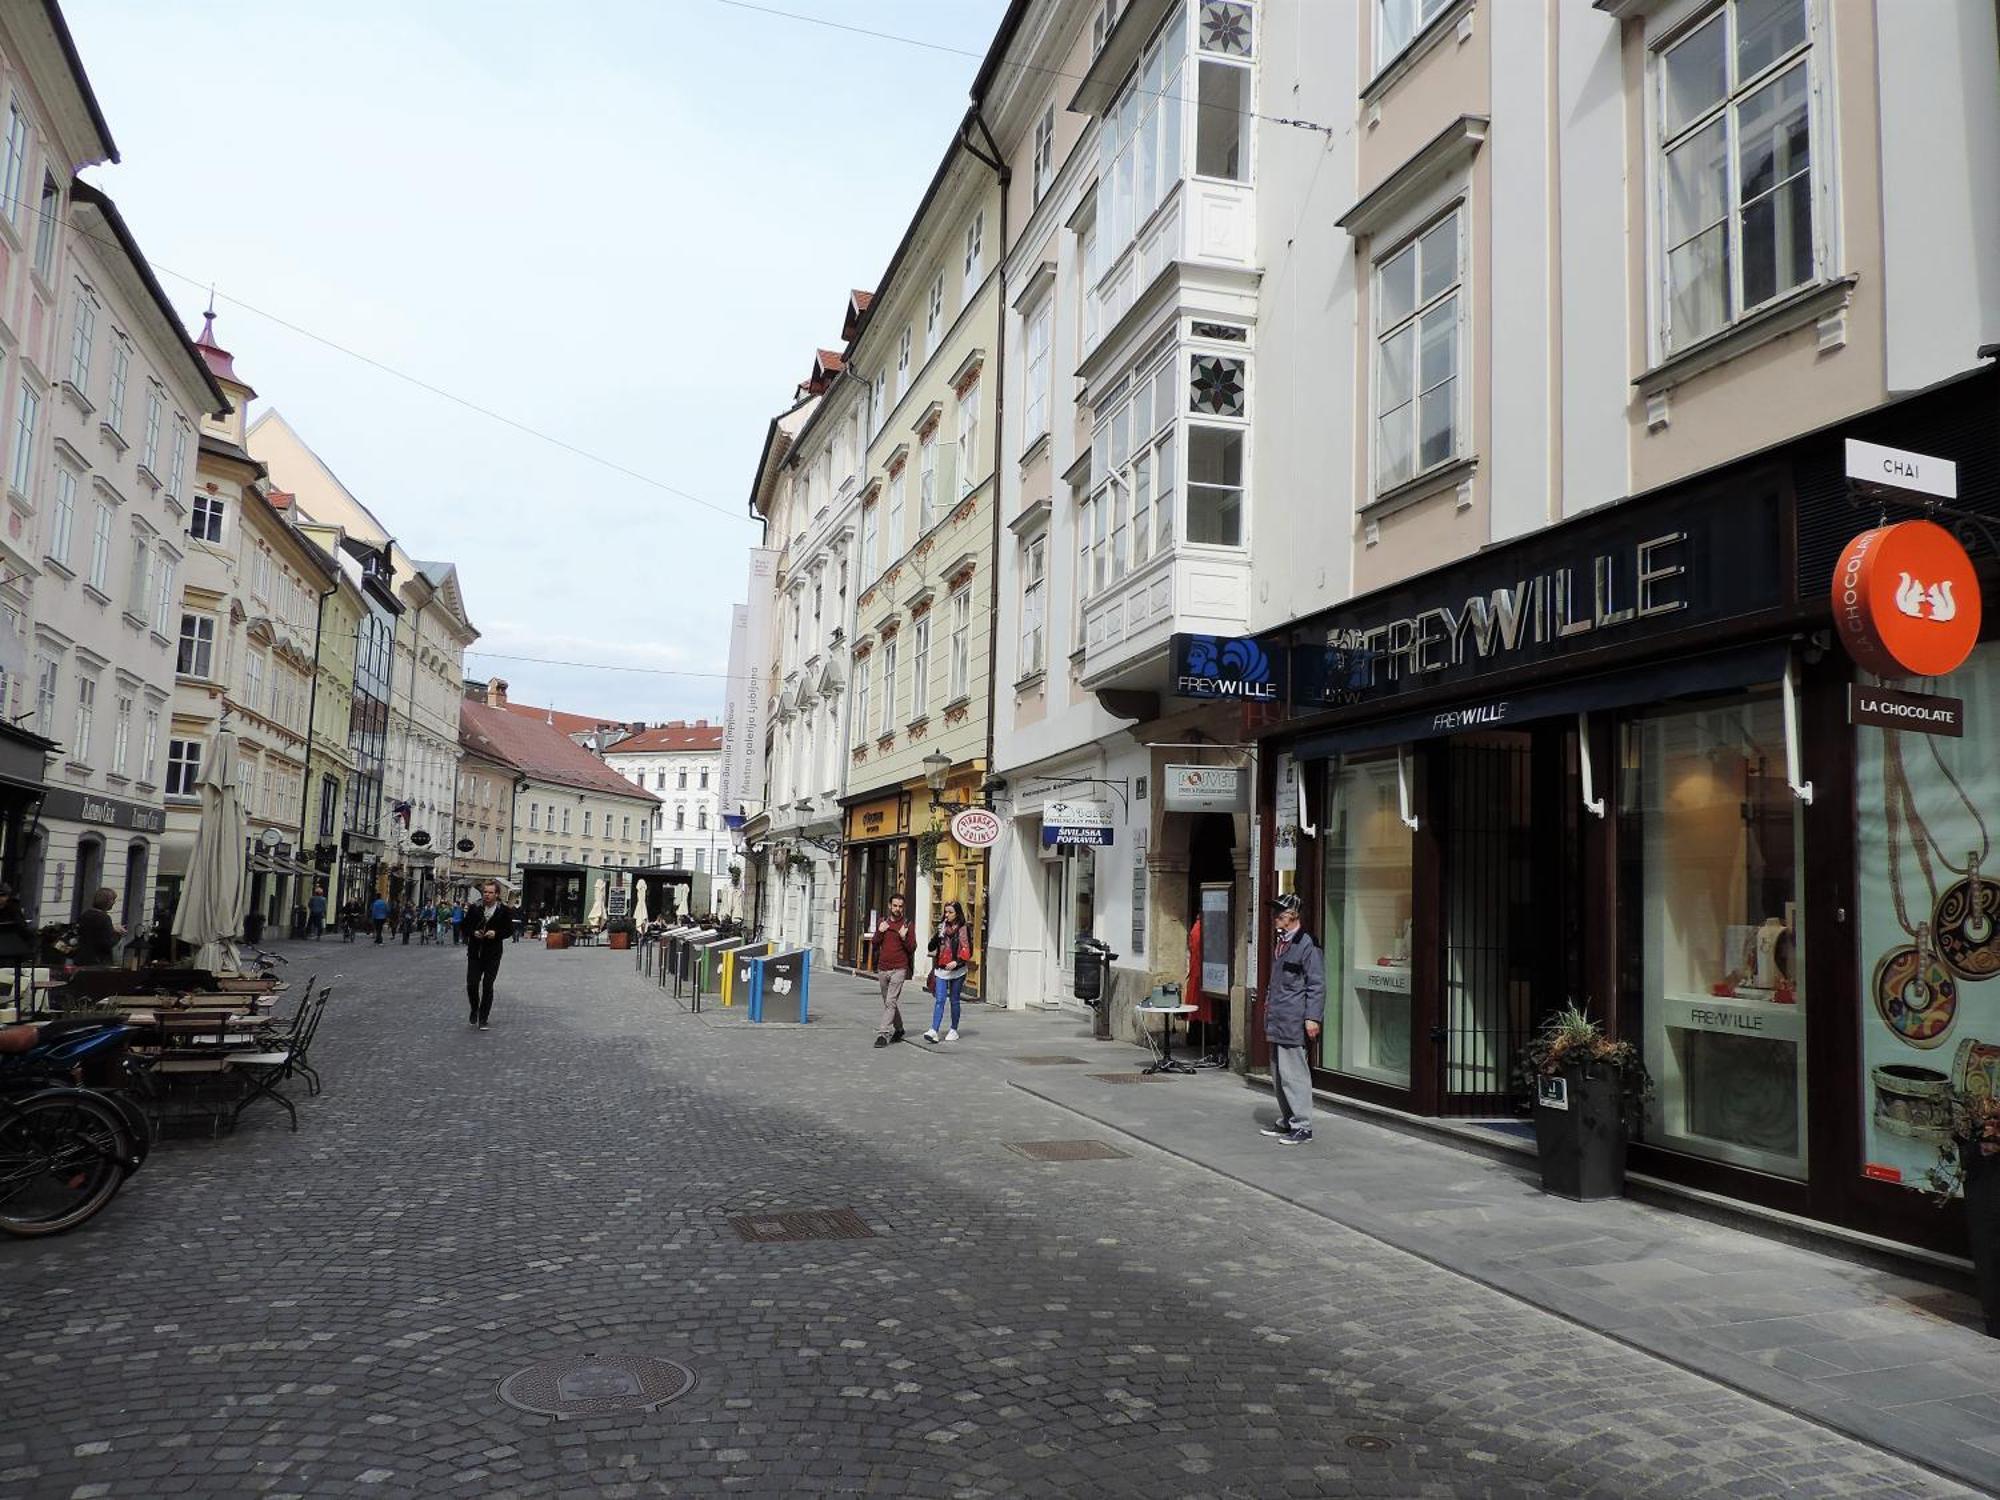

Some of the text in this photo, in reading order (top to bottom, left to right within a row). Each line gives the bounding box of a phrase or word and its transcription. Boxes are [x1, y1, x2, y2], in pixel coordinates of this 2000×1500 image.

[1883, 459, 1919, 479] CHAI
[1843, 531, 1879, 633] CHOCOLAT
[1363, 532, 1688, 690] FREYWILLE
[748, 667, 759, 713] Ljubljana
[1178, 676, 1276, 698] FREYWILLE
[1432, 702, 1509, 731] FREYWILLE
[1860, 699, 1955, 724] LA CHOCOLATE
[745, 717, 757, 755] galerija
[960, 815, 996, 829] PIRANSKA
[1058, 826, 1101, 837] ŠIVILJSKA
[963, 829, 991, 841] SOLINE
[1056, 835, 1103, 844] POPRAVILA
[1691, 1008, 1763, 1031] FREYWILLE
